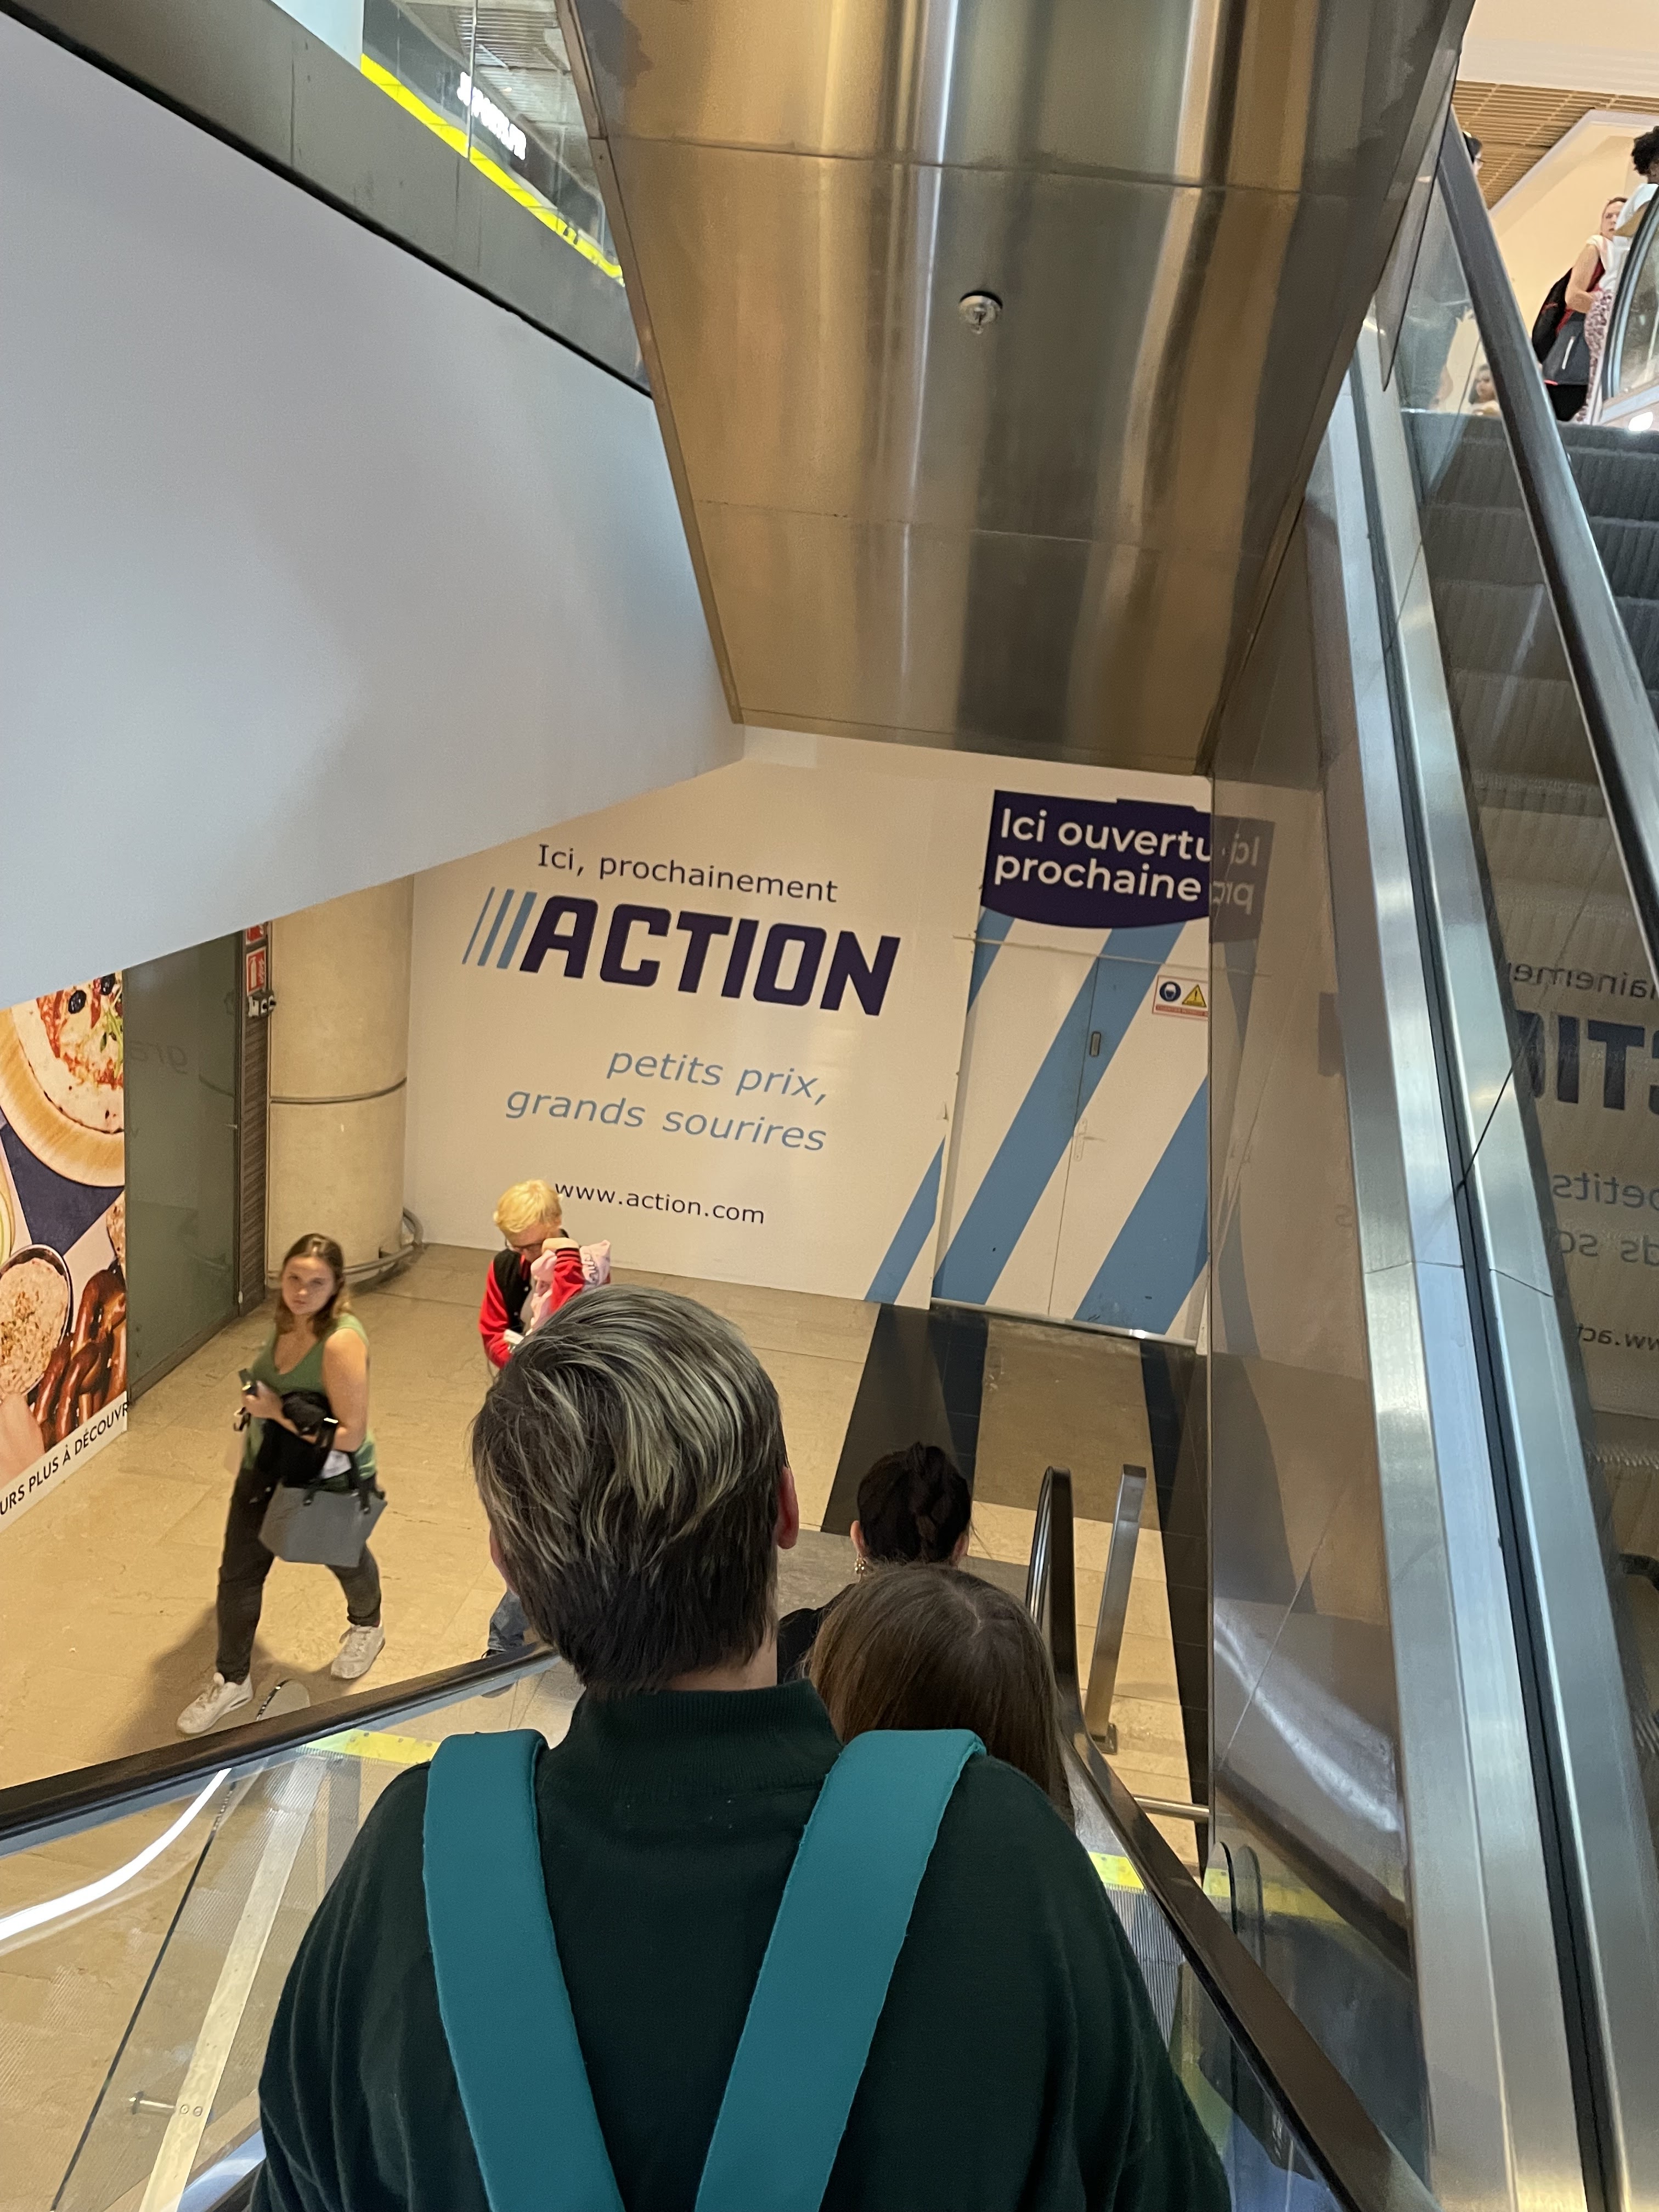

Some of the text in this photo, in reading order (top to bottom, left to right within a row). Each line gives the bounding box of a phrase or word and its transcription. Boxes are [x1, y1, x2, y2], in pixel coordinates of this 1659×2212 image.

[1001, 808, 1047, 843] Ici
[538, 843, 839, 903] Ici, prochainement
[994, 854, 1202, 901] prochaine
[519, 895, 901, 1017] ACTION
[606, 1051, 827, 1106] petits prix,
[505, 1091, 827, 1151] grands sourires
[555, 1183, 765, 1225] www.action.com
[29, 1457, 59, 1493] PLUS
